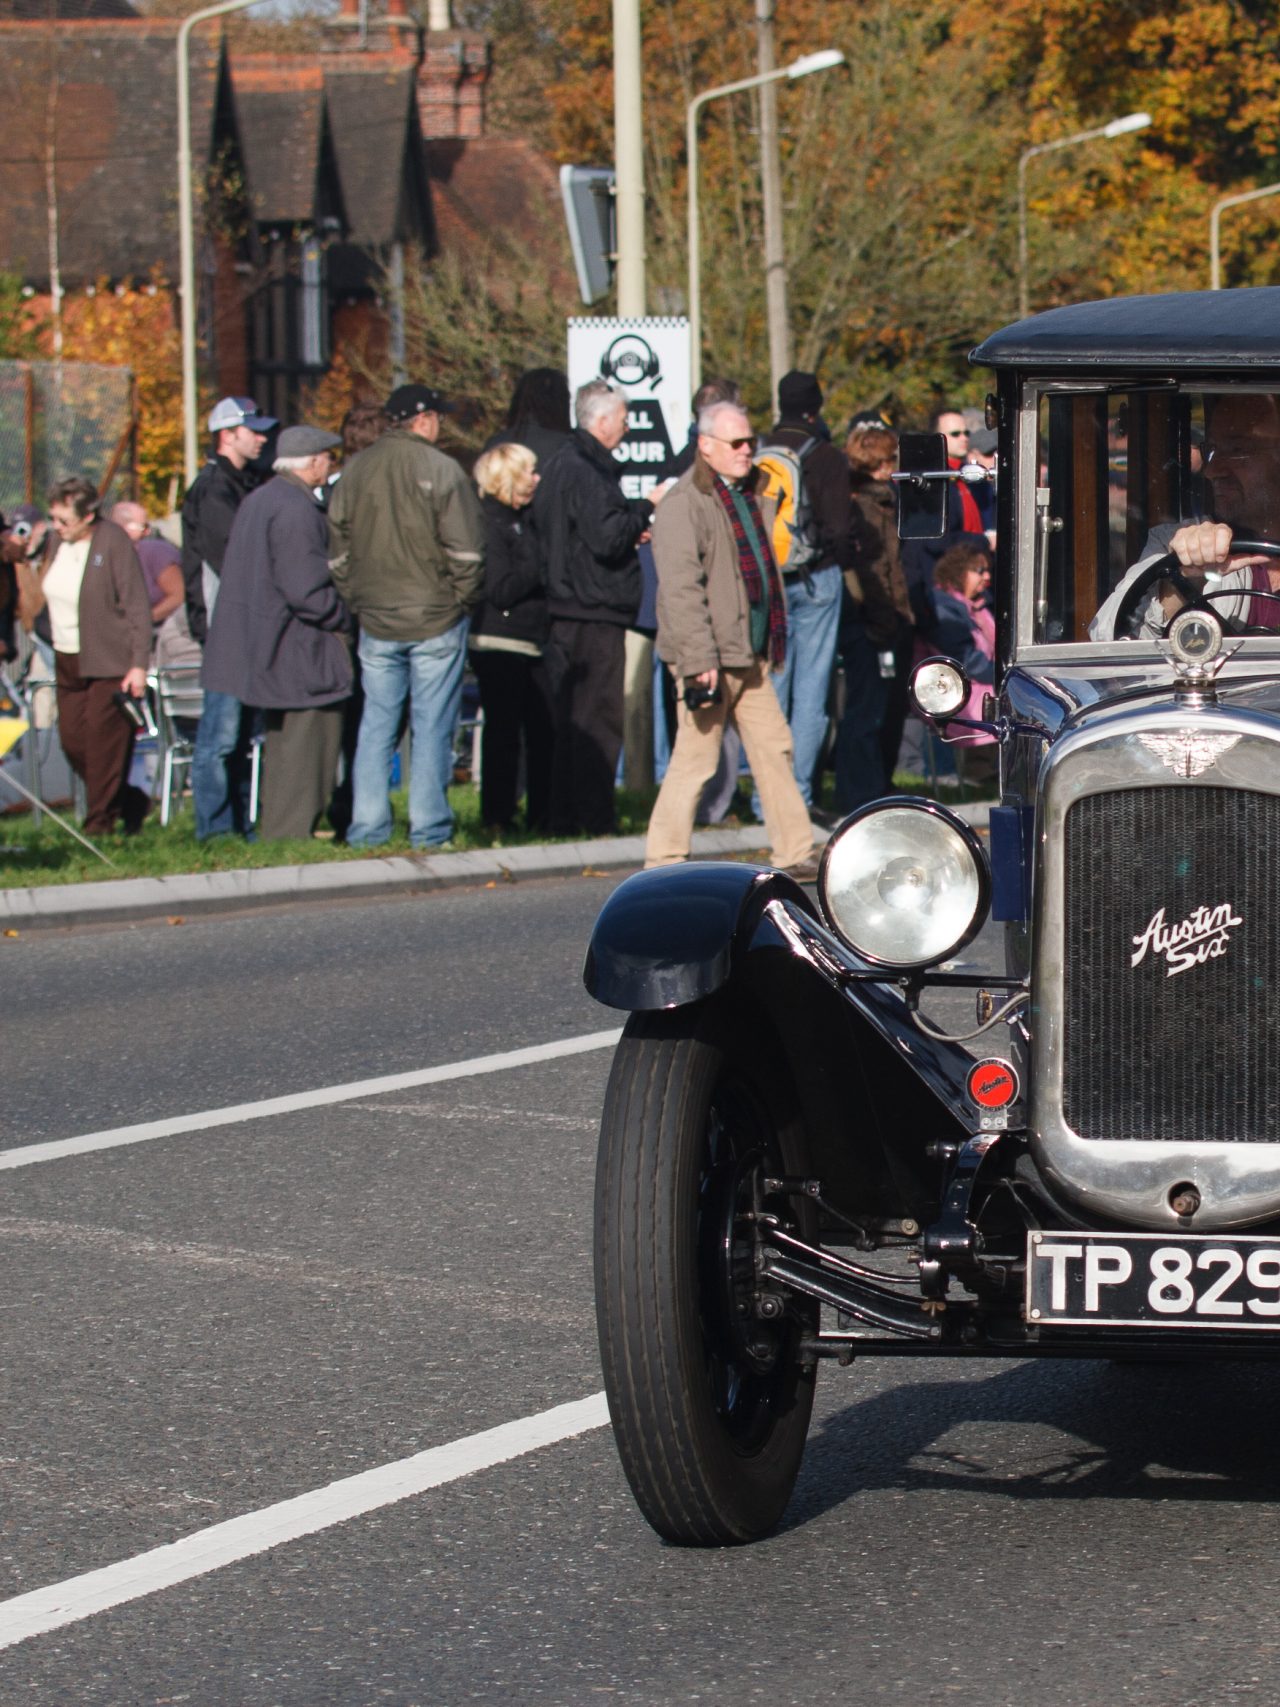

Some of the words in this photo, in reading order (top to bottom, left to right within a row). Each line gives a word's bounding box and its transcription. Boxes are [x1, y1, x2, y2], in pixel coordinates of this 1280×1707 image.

[1131, 904, 1242, 968] Austin
[1166, 929, 1230, 977] Six
[1036, 1244, 1133, 1312] TP
